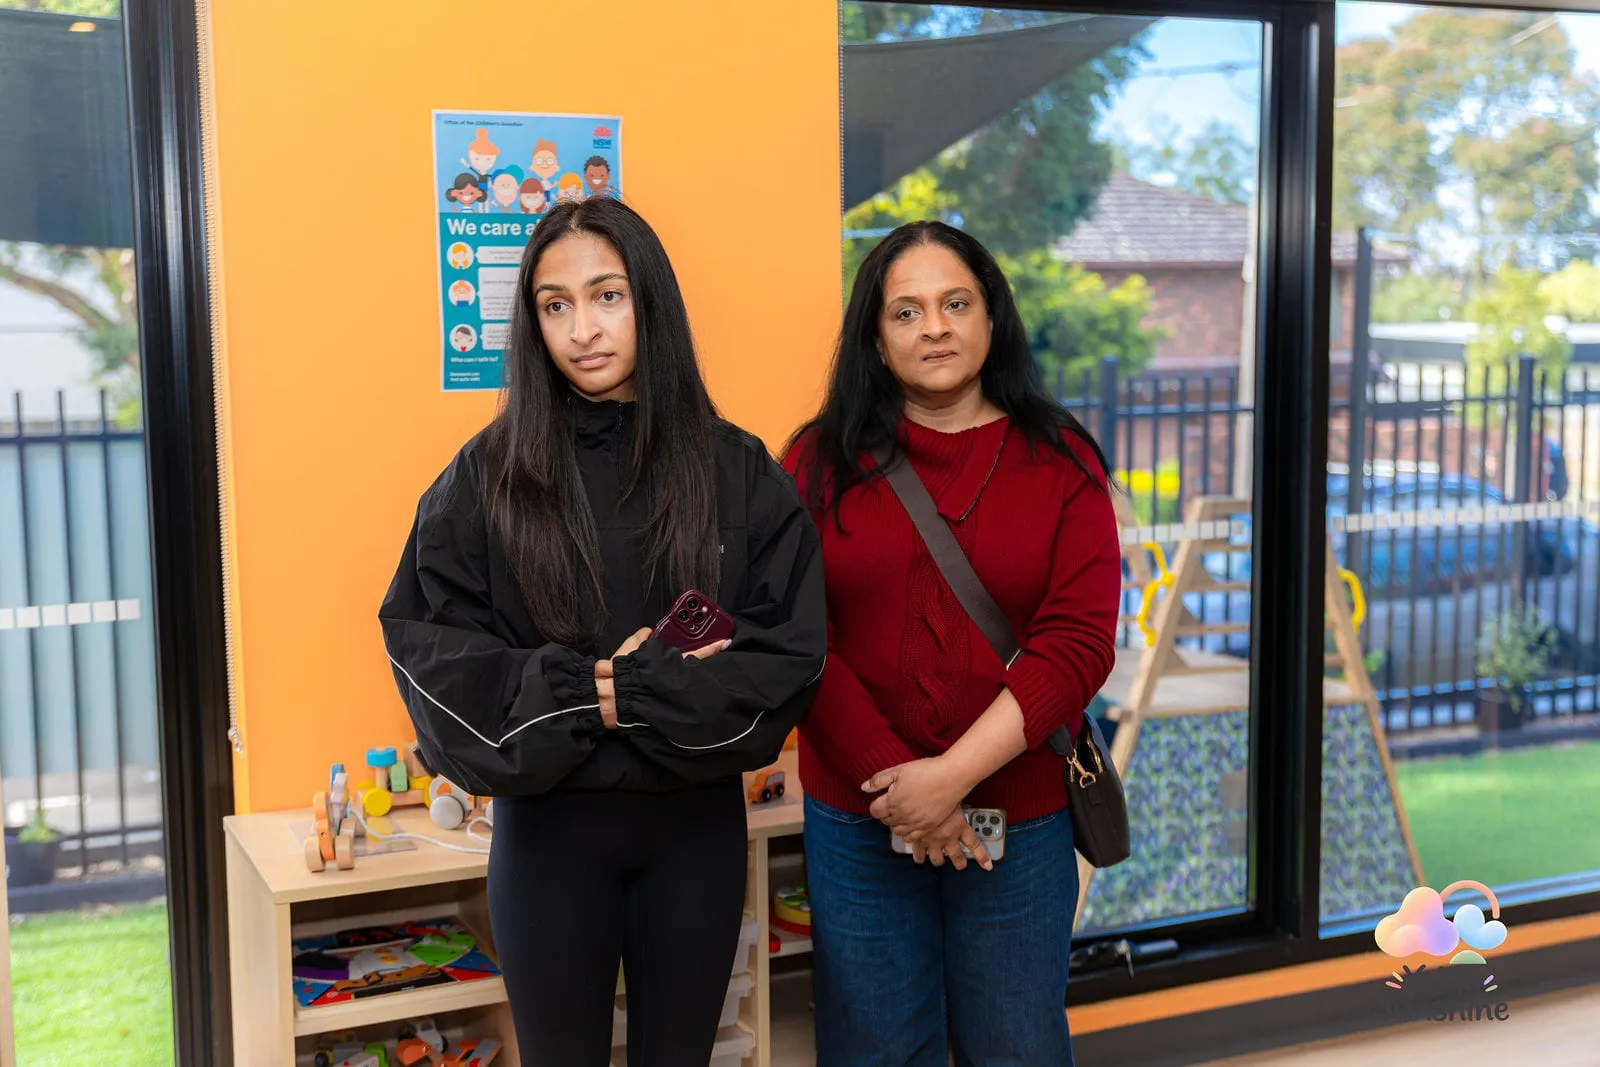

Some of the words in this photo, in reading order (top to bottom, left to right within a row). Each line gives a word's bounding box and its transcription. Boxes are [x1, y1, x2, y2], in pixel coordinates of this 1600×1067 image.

[592, 139, 613, 147] NSW
[446, 218, 477, 236] We
[480, 222, 522, 236] care
